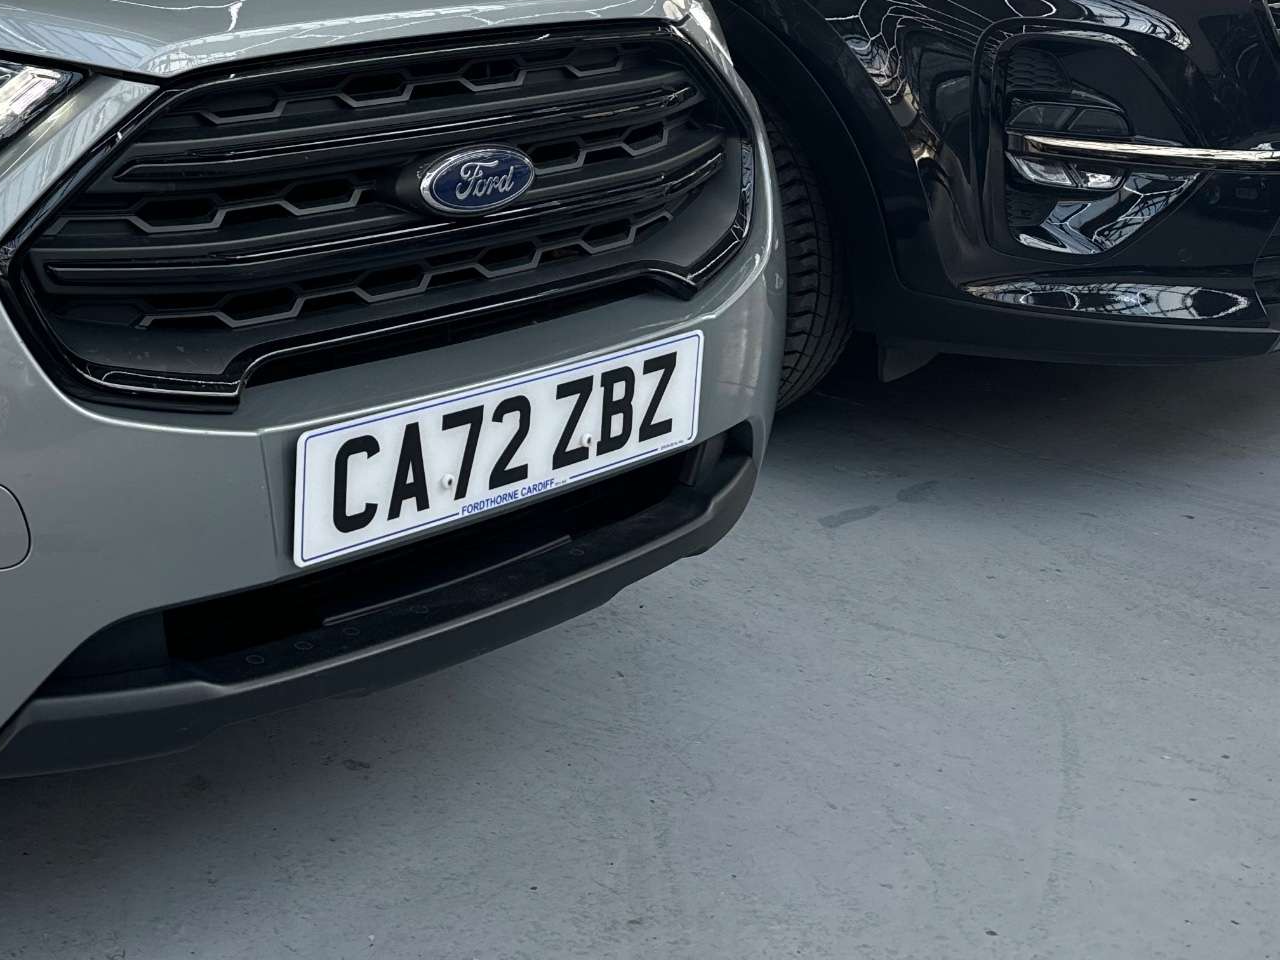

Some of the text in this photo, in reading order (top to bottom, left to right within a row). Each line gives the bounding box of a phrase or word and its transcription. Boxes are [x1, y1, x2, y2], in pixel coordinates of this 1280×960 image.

[455, 159, 516, 200] Ford
[331, 351, 678, 534] CA72 ZBZ
[461, 478, 555, 515] FORDTHORNE CARDIFF
